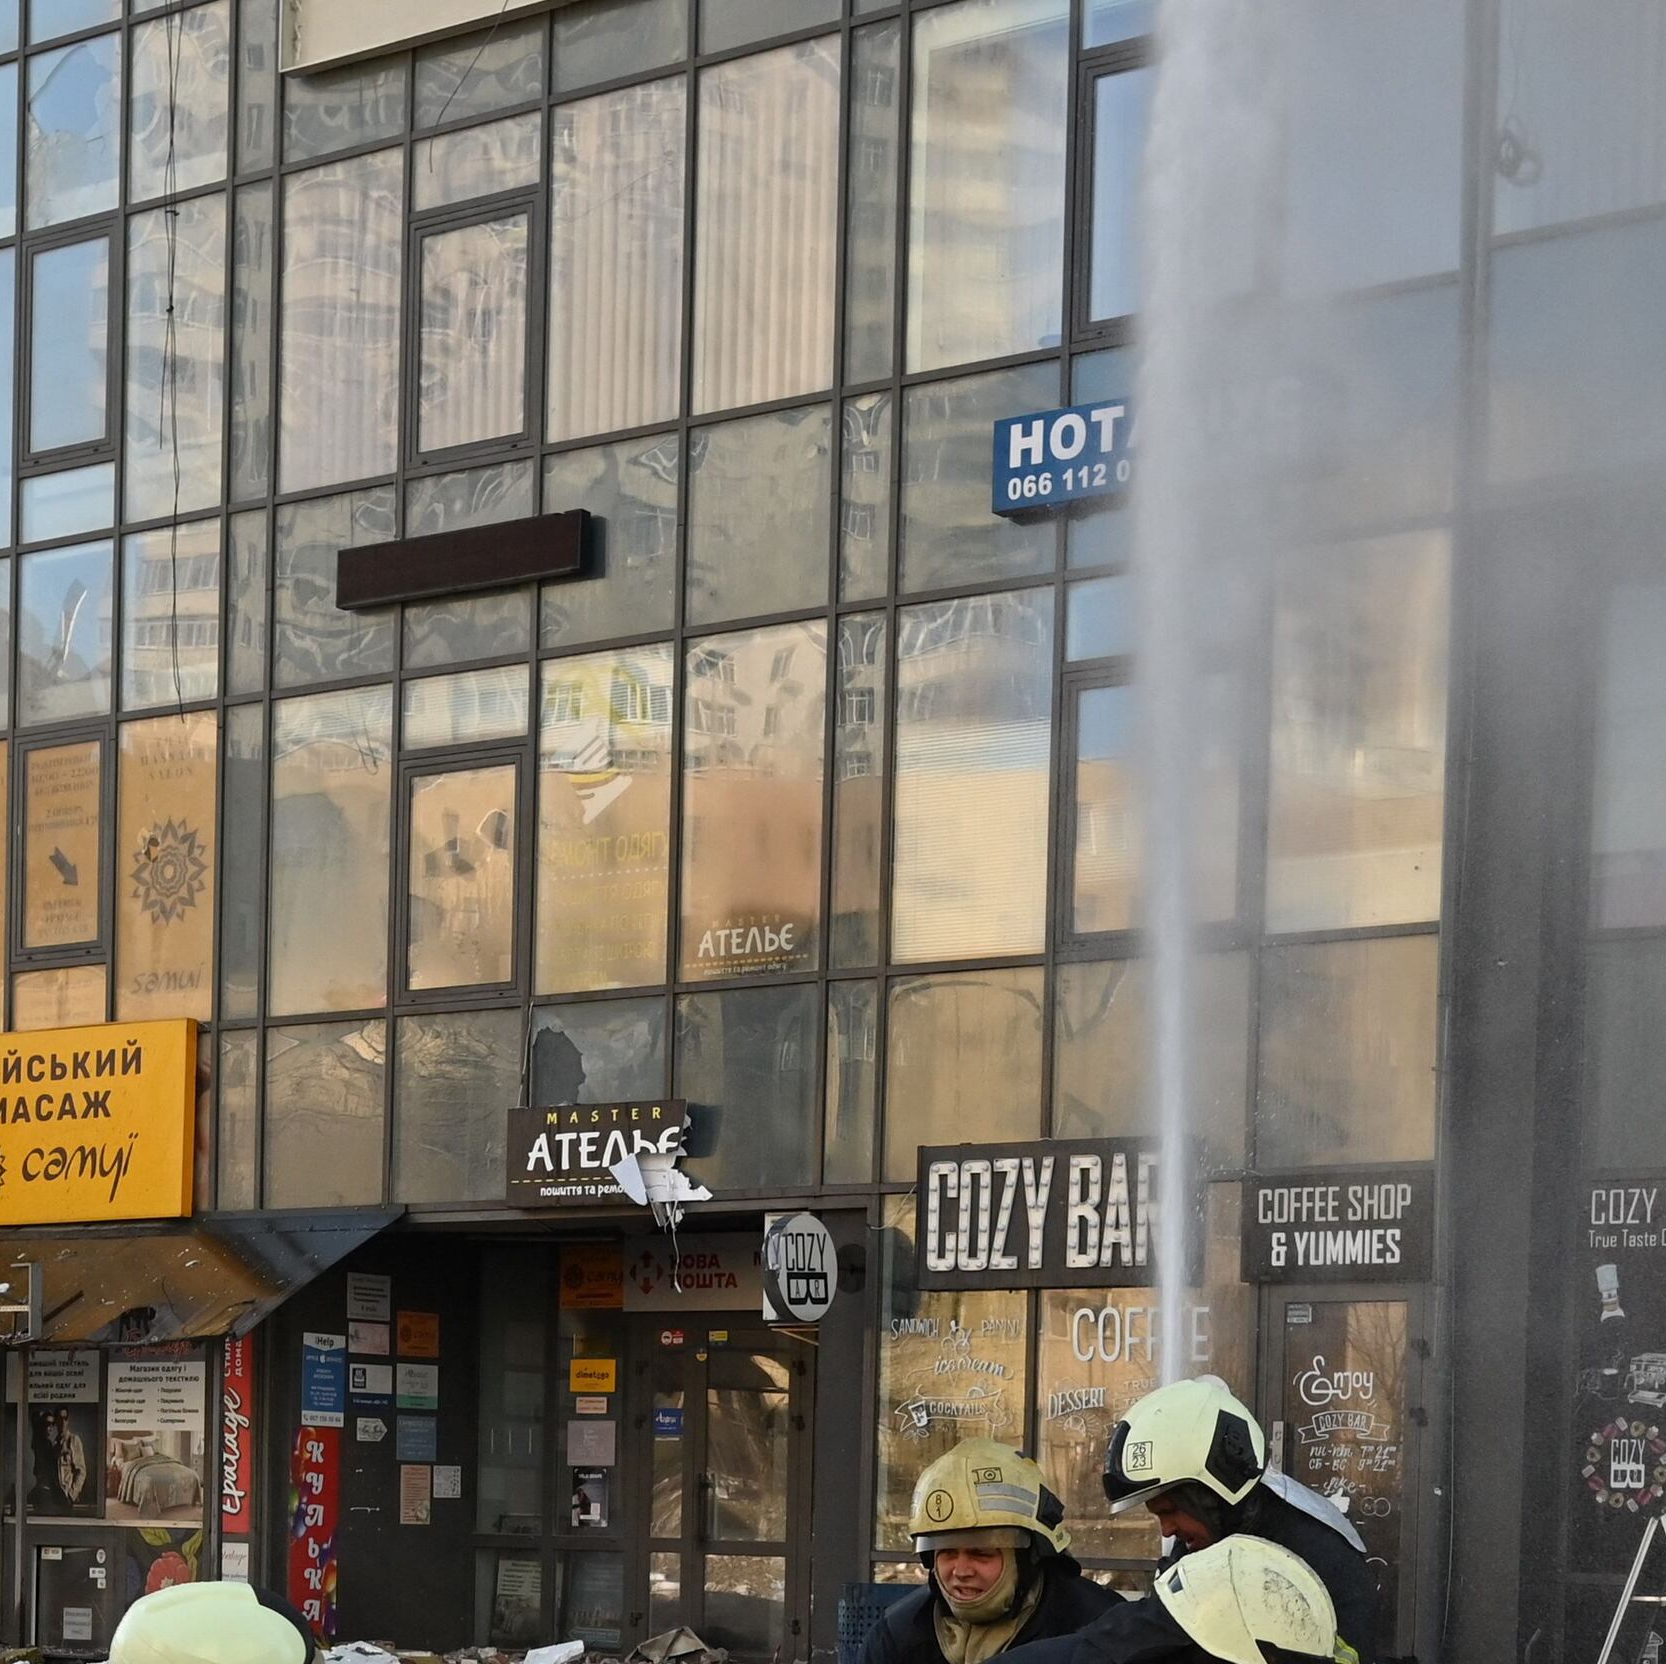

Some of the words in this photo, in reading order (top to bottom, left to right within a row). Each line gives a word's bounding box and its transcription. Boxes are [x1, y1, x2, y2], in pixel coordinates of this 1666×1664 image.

[1008, 473, 1052, 501] 066
[1062, 463, 1106, 491] 112
[698, 923, 795, 958] АТЕЛЬЄ
[547, 1106, 662, 1125] MASTER
[21, 1131, 139, 1204] самуї
[540, 1184, 583, 1198] пошиття
[585, 1184, 596, 1197] та
[1258, 1186, 1341, 1224] COFFEE
[1347, 1183, 1412, 1221] SHOP
[926, 1154, 1056, 1272] COZY
[1590, 1188, 1657, 1225] COZY
[786, 1232, 827, 1272] COZY
[1271, 1231, 1288, 1267] &
[1293, 1228, 1402, 1267] YUMMIES
[1588, 1229, 1619, 1249] True
[1621, 1229, 1657, 1248] Taste
[669, 1253, 721, 1270] НОВА
[669, 1272, 738, 1289] ПОШТА
[891, 1318, 939, 1341] SANDWICH
[981, 1318, 1021, 1337] PANINI
[957, 1357, 1006, 1377] cream
[1299, 1355, 1374, 1406] Enjoy
[929, 1401, 987, 1416] COCKTAILS
[1045, 1386, 1107, 1421] DESSERT
[1318, 1414, 1345, 1429] COZY
[1346, 1413, 1367, 1427] BAR
[1132, 1444, 1147, 1455] 26
[1132, 1456, 1147, 1469] 23
[1610, 1438, 1647, 1466] COZY
[302, 1440, 325, 1622] КУЛЬКА
